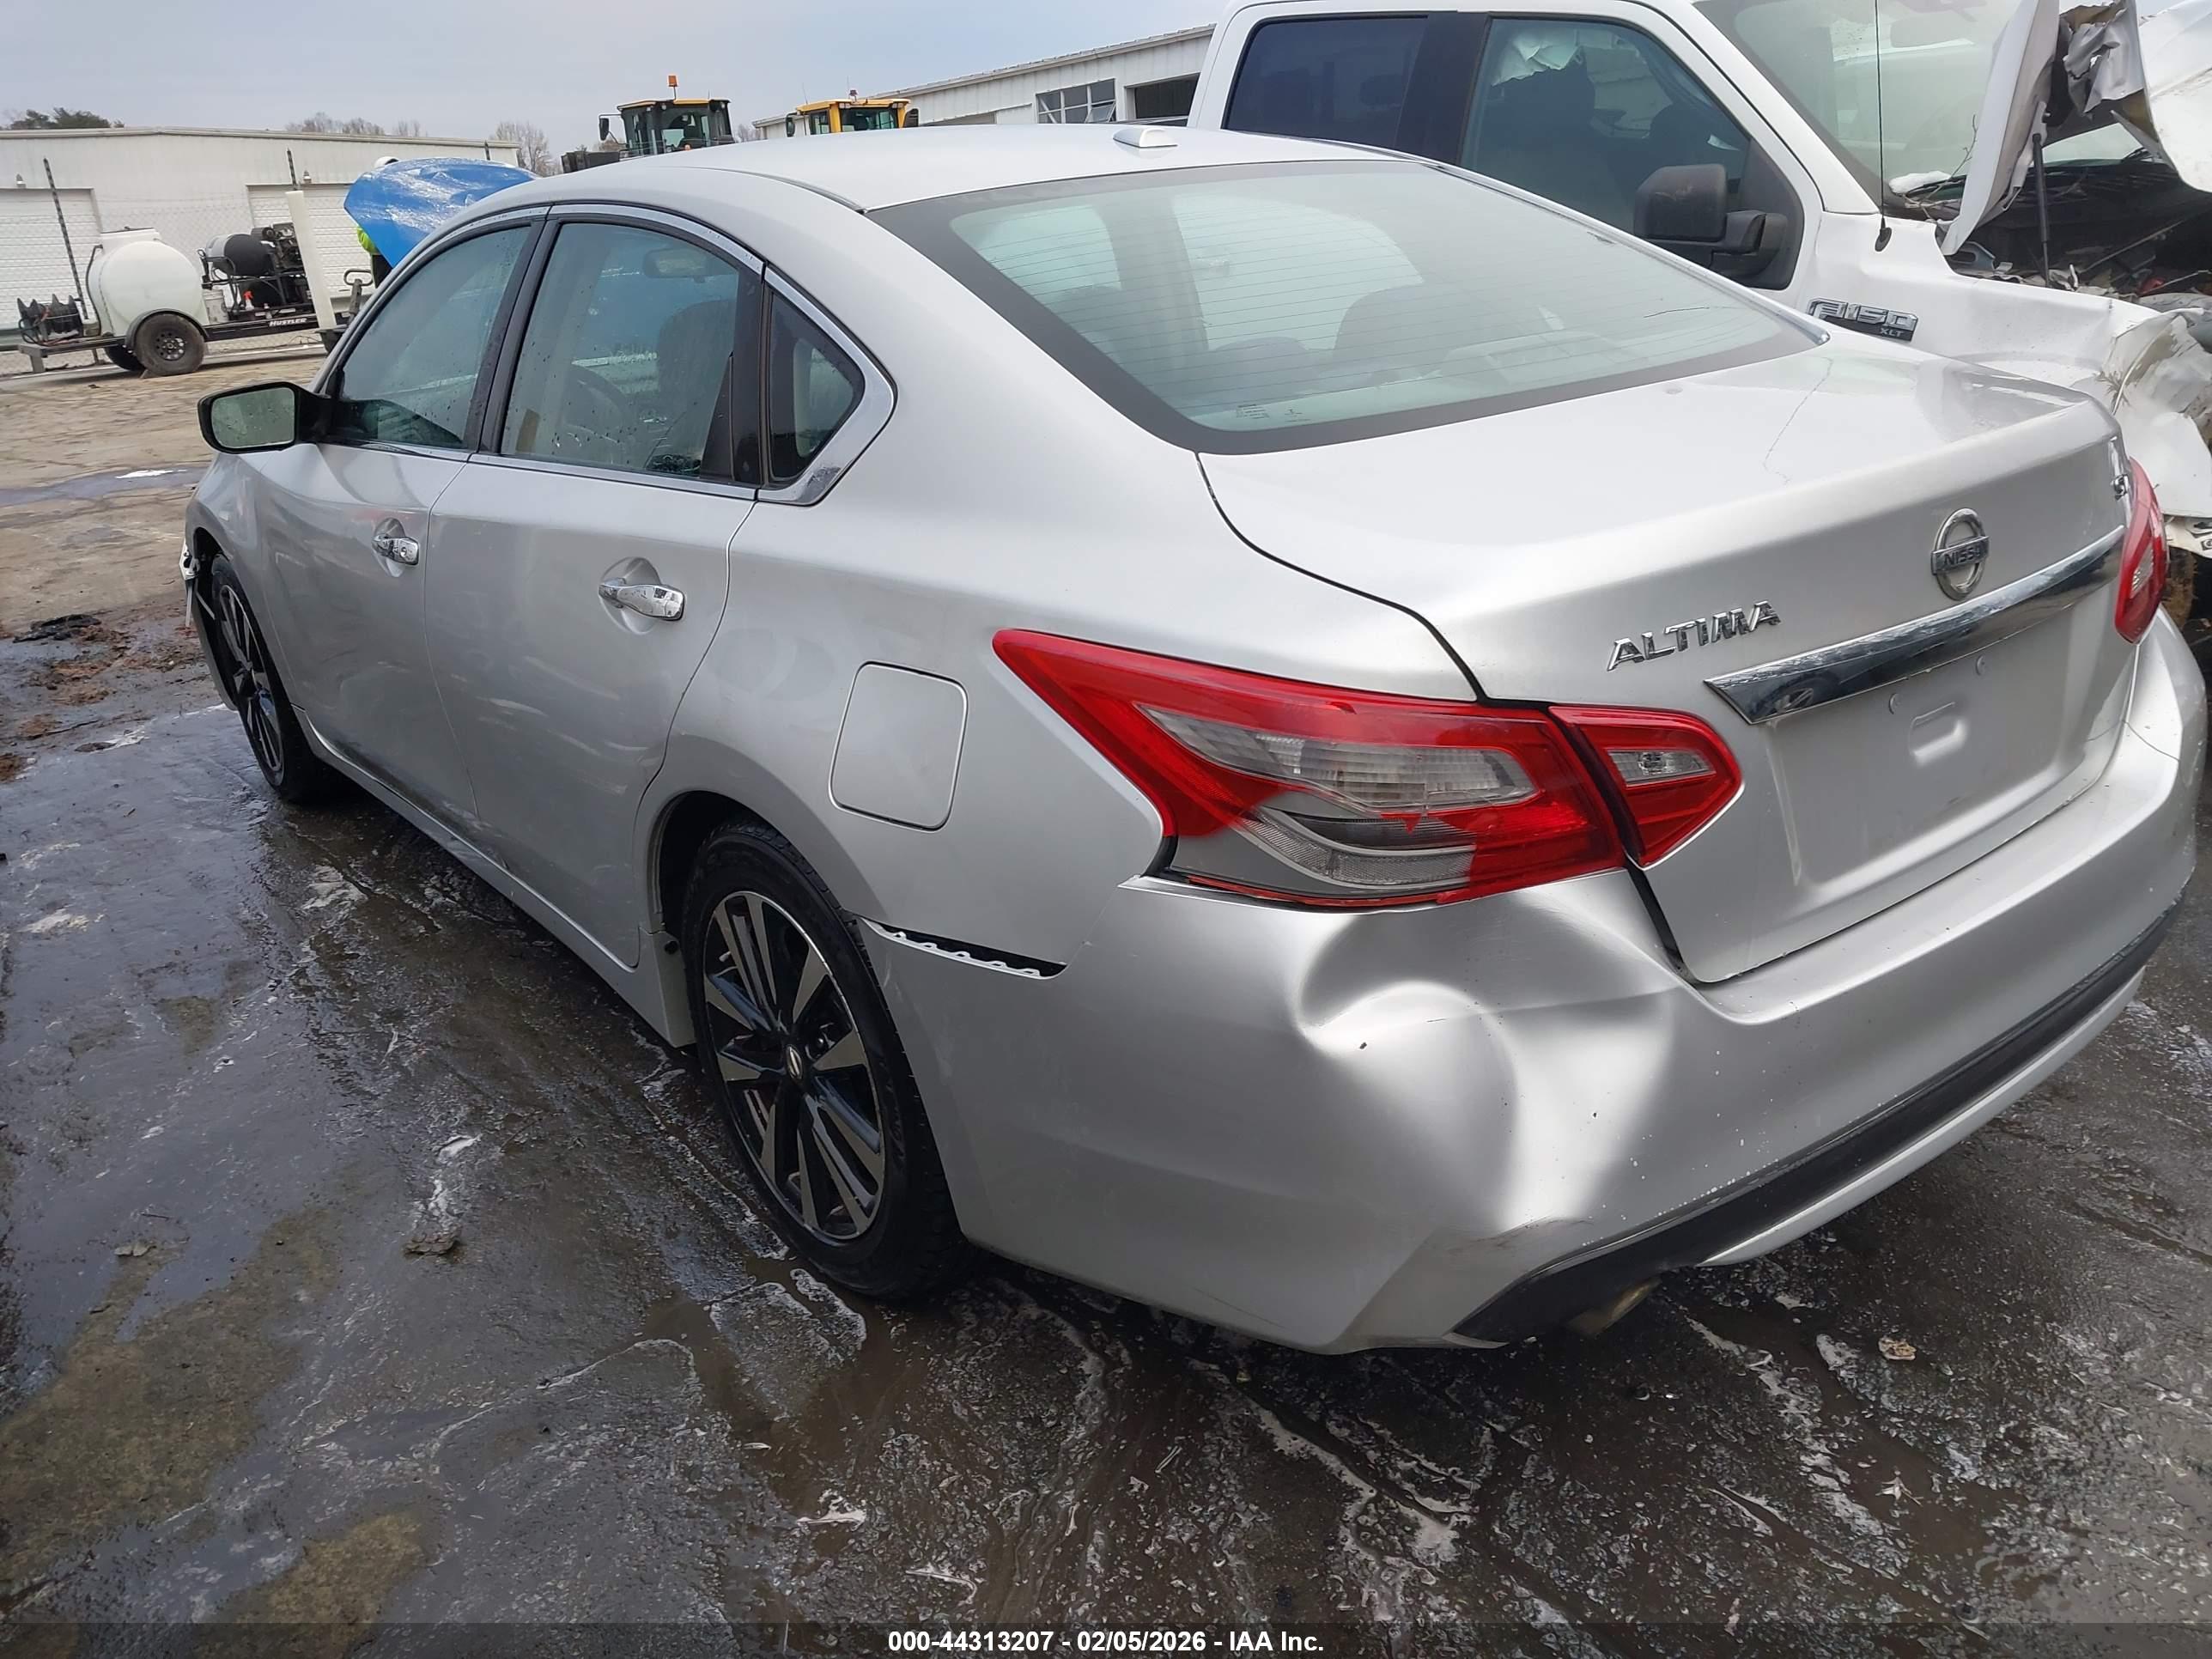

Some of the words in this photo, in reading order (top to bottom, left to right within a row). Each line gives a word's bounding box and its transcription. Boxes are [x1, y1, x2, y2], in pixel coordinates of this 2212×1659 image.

[269, 318, 307, 327] HUSTLER
[1880, 327, 1904, 337] XLT
[1607, 600, 1781, 672] ALTIMA
